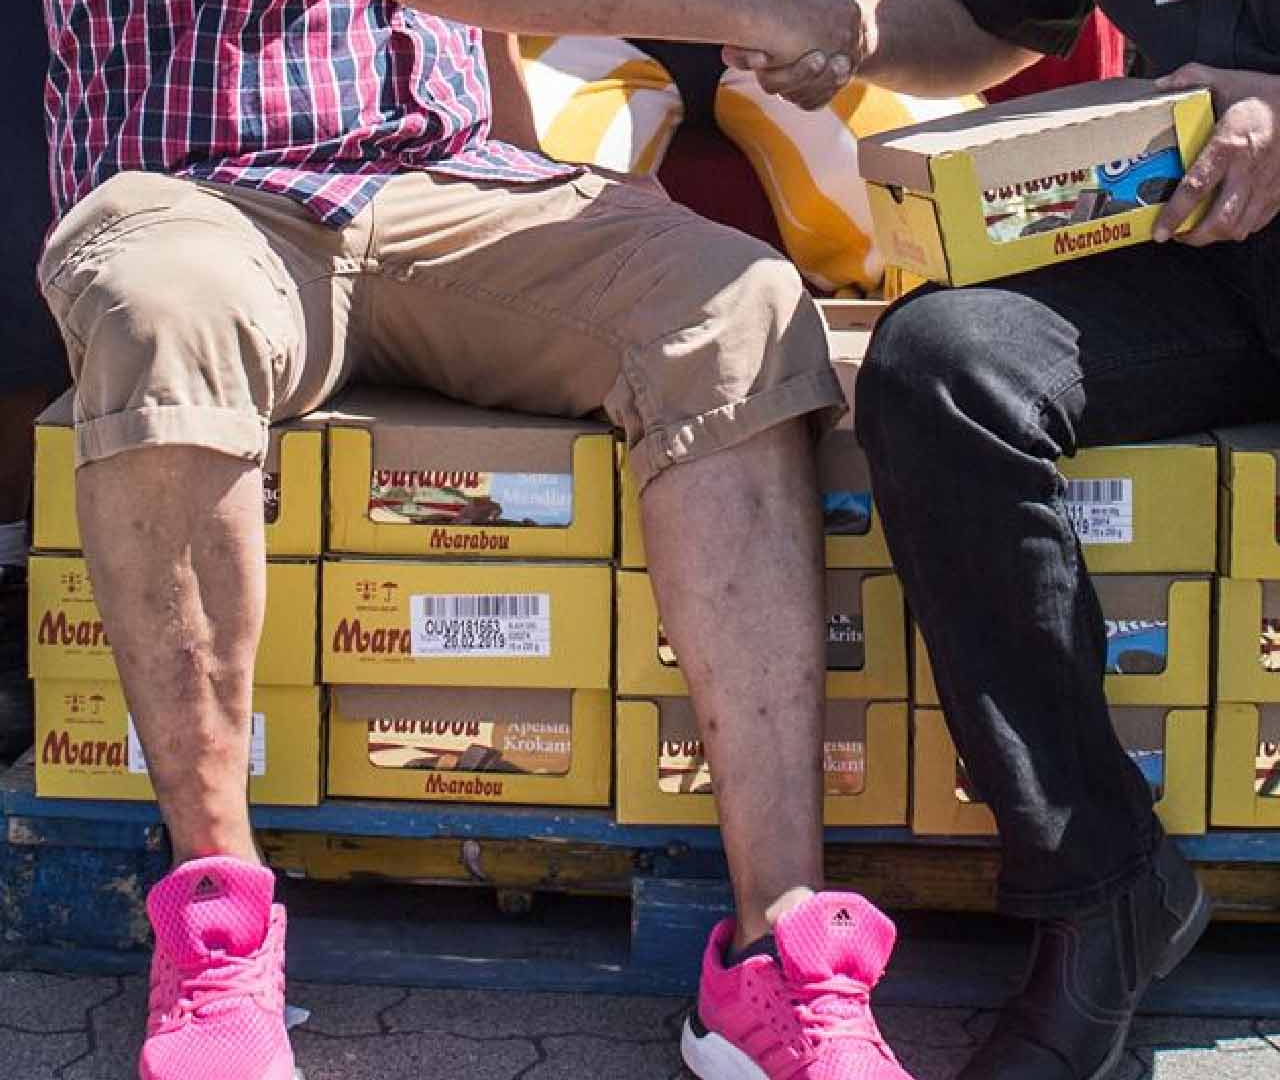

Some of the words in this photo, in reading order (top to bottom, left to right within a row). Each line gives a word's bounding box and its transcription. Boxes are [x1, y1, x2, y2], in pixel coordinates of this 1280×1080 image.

[1053, 222, 1131, 255] Marabou
[429, 527, 510, 550] Marabou
[425, 773, 504, 796] Marabou
